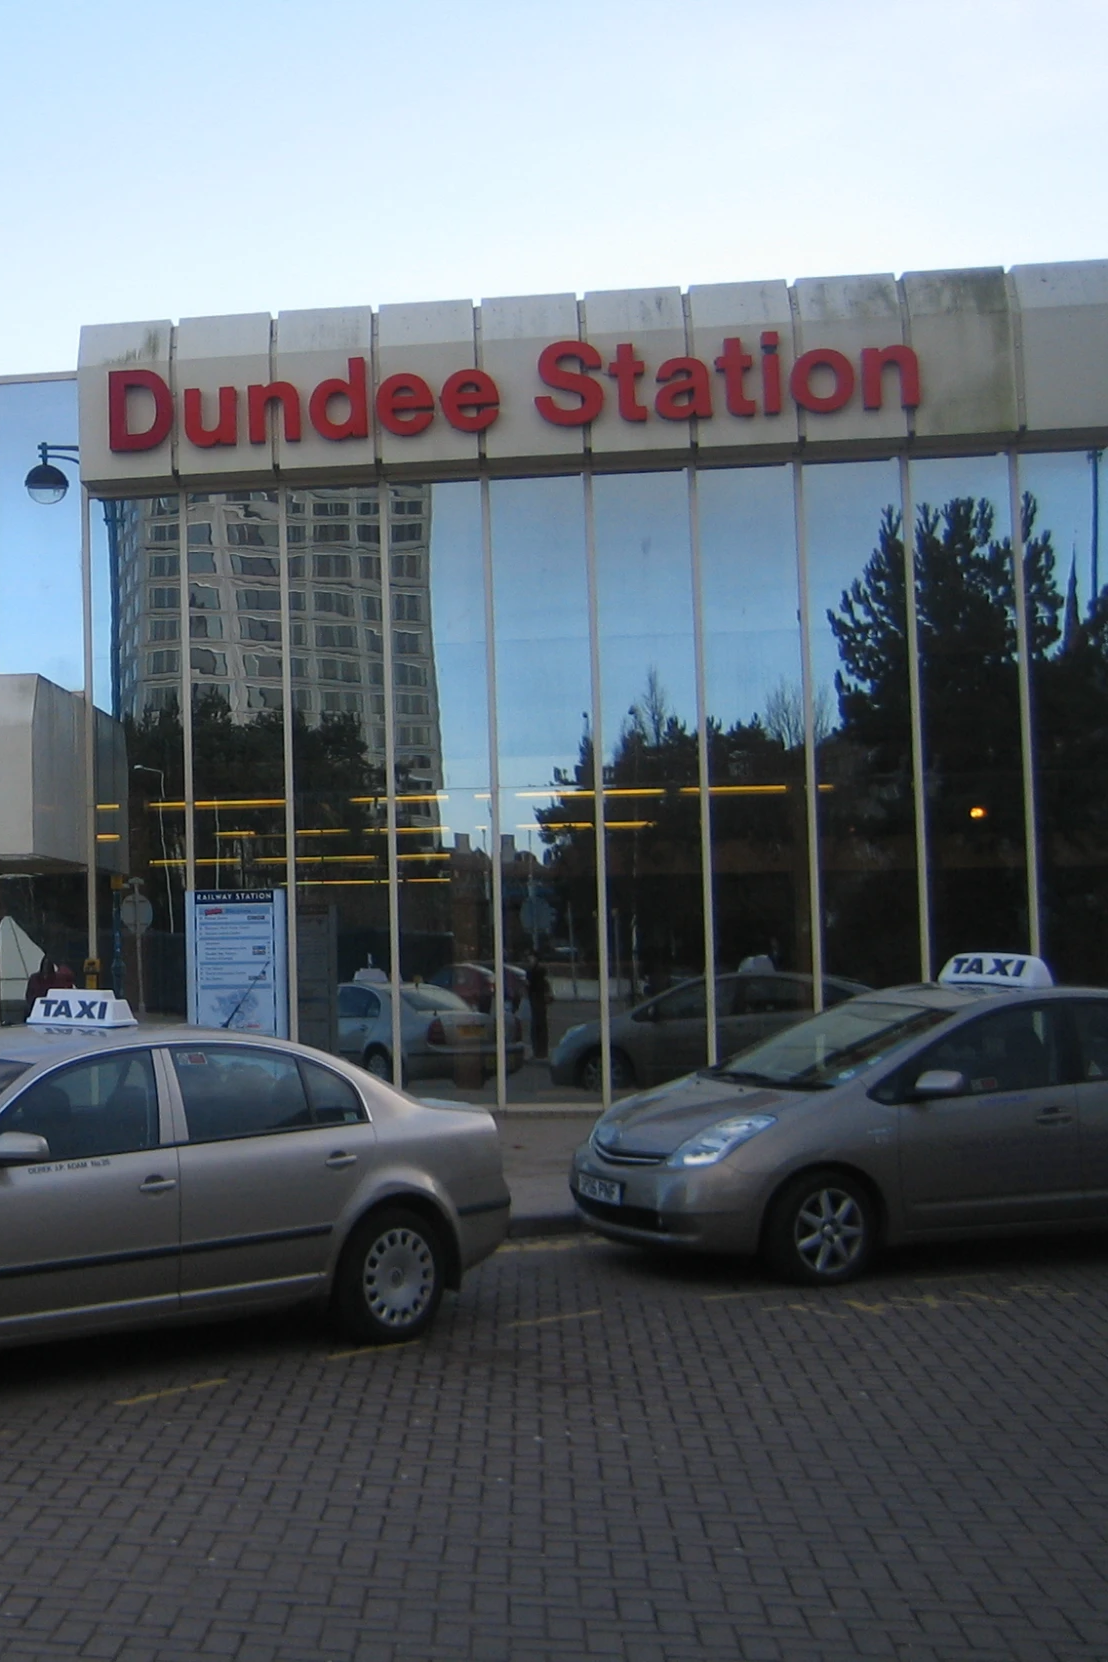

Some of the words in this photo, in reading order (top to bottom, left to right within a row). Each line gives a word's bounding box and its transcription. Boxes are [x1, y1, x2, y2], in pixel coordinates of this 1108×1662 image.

[108, 355, 501, 452] Dundee
[533, 331, 922, 427] Station
[196, 893, 233, 901] RAILWAY
[235, 892, 272, 900] STATION
[953, 957, 1027, 977] TAXI
[40, 1000, 108, 1020] TAXI
